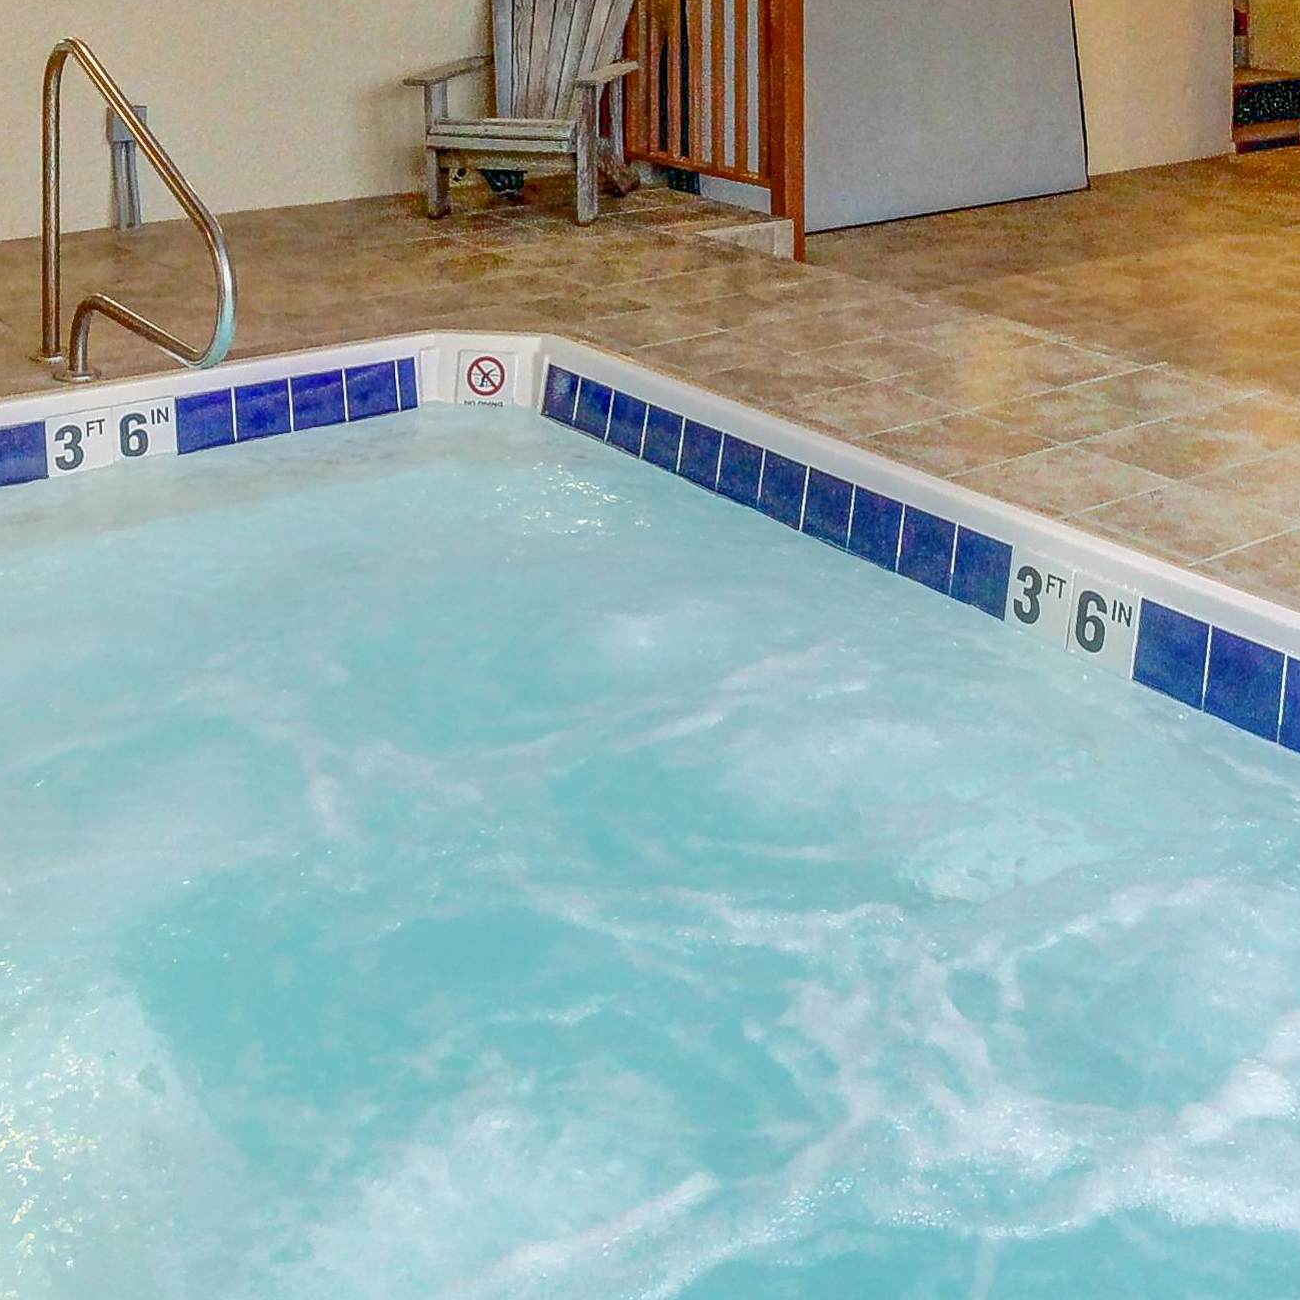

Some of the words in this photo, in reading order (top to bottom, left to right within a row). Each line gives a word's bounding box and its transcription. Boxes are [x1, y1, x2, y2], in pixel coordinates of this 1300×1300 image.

[54, 425, 85, 471] 3
[86, 418, 106, 437] FT
[119, 412, 149, 457] 6
[151, 406, 170, 425] IN
[1013, 565, 1042, 624] 3
[1045, 573, 1067, 599] FT
[1075, 590, 1108, 653] 6
[1111, 599, 1133, 628] IN
